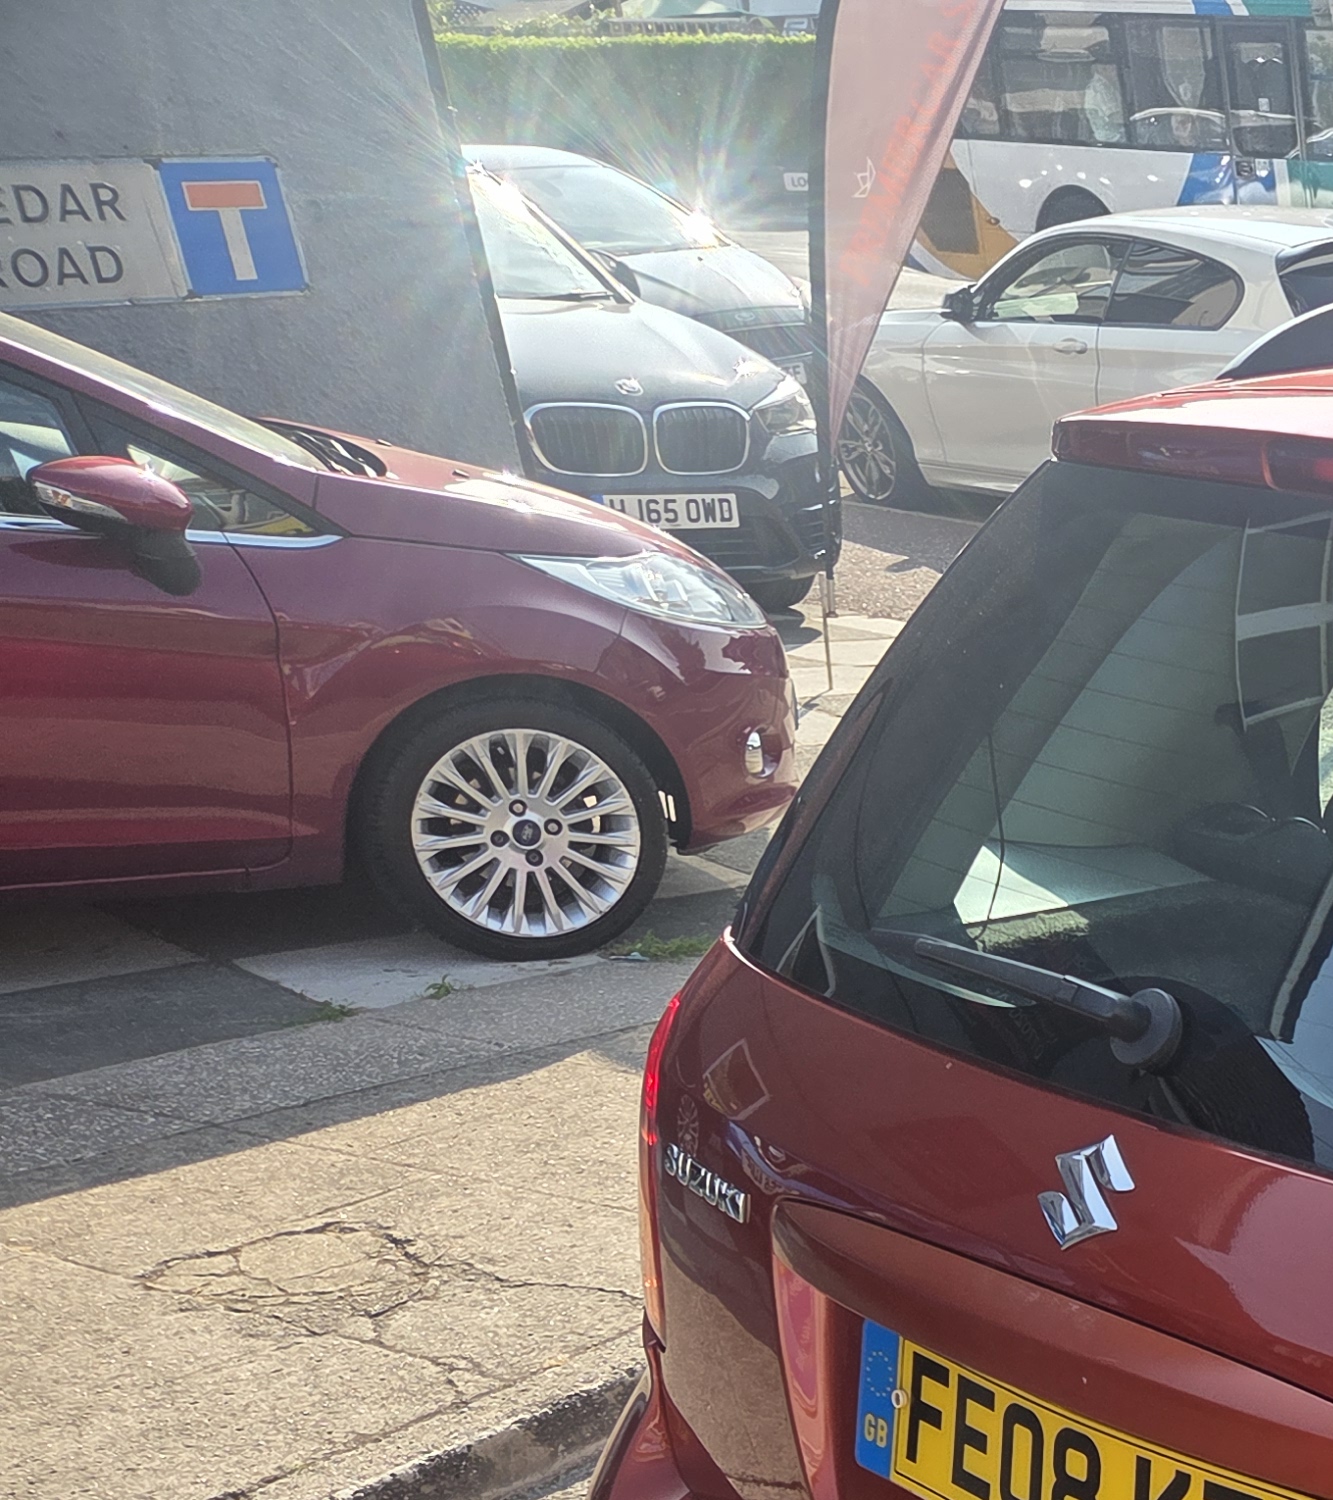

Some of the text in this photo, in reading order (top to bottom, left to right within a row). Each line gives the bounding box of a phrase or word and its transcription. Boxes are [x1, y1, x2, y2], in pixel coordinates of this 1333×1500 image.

[0, 245, 124, 289] OAD
[685, 497, 734, 524] OWD
[664, 1142, 752, 1224] SUZUKI
[863, 1412, 888, 1449] GB
